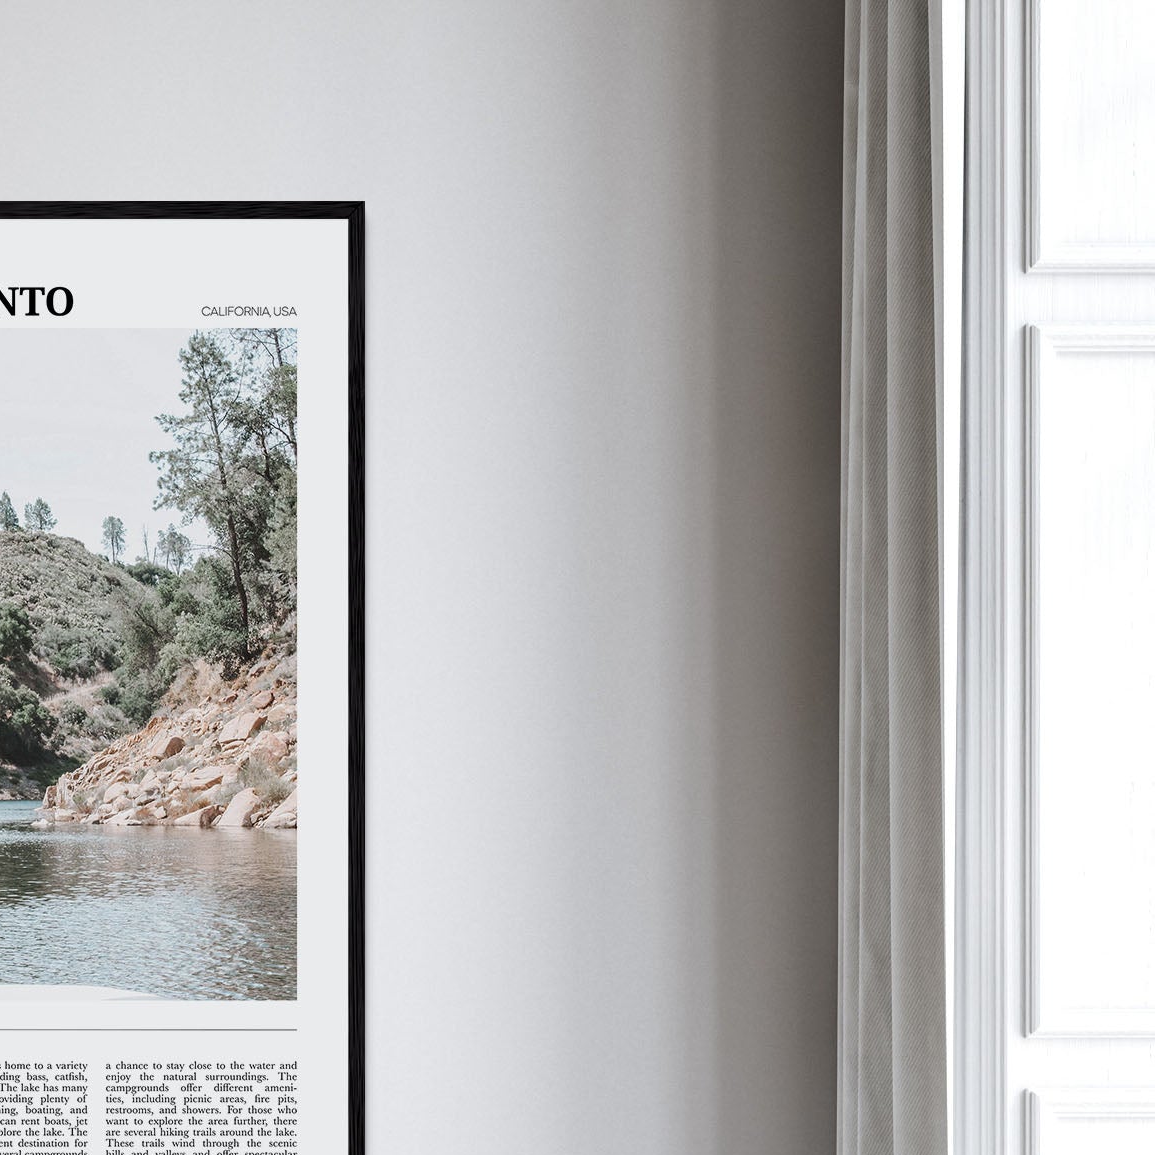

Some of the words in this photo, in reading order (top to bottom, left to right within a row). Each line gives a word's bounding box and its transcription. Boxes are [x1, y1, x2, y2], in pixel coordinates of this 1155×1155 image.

[201, 305, 271, 318] CALIFORNIA,
[273, 305, 298, 317] USA
[116, 1061, 149, 1070] chance
[153, 1062, 163, 1070] to
[166, 1062, 185, 1072] stay
[189, 1061, 212, 1070] close
[216, 1062, 226, 1070] to
[230, 1061, 245, 1070] the
[249, 1062, 276, 1070] water
[279, 1061, 297, 1070] and
[27, 1072, 49, 1082] bass,
[55, 1072, 88, 1082] catfish,
[105, 1072, 131, 1083] enjoy
[140, 1072, 155, 1081] the
[163, 1072, 197, 1081] natural
[205, 1072, 269, 1083] surroundings.
[278, 1072, 297, 1081] The
[105, 1083, 169, 1094] campgrounds
[180, 1083, 202, 1092] offer
[213, 1083, 253, 1092] different
[265, 1083, 297, 1092] ameni-
[40, 1094, 70, 1105] plenty
[77, 1094, 87, 1103] of
[106, 1094, 124, 1104] ties,
[132, 1094, 176, 1105] including
[184, 1094, 212, 1105] picnic
[255, 1094, 270, 1103] fire
[278, 1094, 297, 1105] pits,
[26, 1105, 63, 1117] boating,
[70, 1105, 88, 1114] and
[106, 1106, 154, 1116] restrooms,
[159, 1105, 177, 1114] and
[182, 1105, 222, 1114] showers.
[227, 1105, 243, 1114] For
[248, 1105, 272, 1114] those
[277, 1105, 298, 1114] who
[21, 1117, 40, 1125] rent
[45, 1116, 72, 1127] boats,
[76, 1116, 88, 1128] jet
[105, 1117, 129, 1125] want
[134, 1117, 144, 1125] to
[148, 1116, 183, 1128] explore
[188, 1116, 203, 1125] the
[234, 1116, 268, 1127] further,
[273, 1116, 297, 1125] there
[18, 1139, 69, 1148] destination
[74, 1139, 88, 1148] for
[106, 1139, 134, 1148] These
[142, 1139, 165, 1148] trails
[172, 1139, 195, 1148] wind
[203, 1139, 239, 1150] through
[247, 1139, 262, 1148] the
[269, 1139, 297, 1148] scenic
